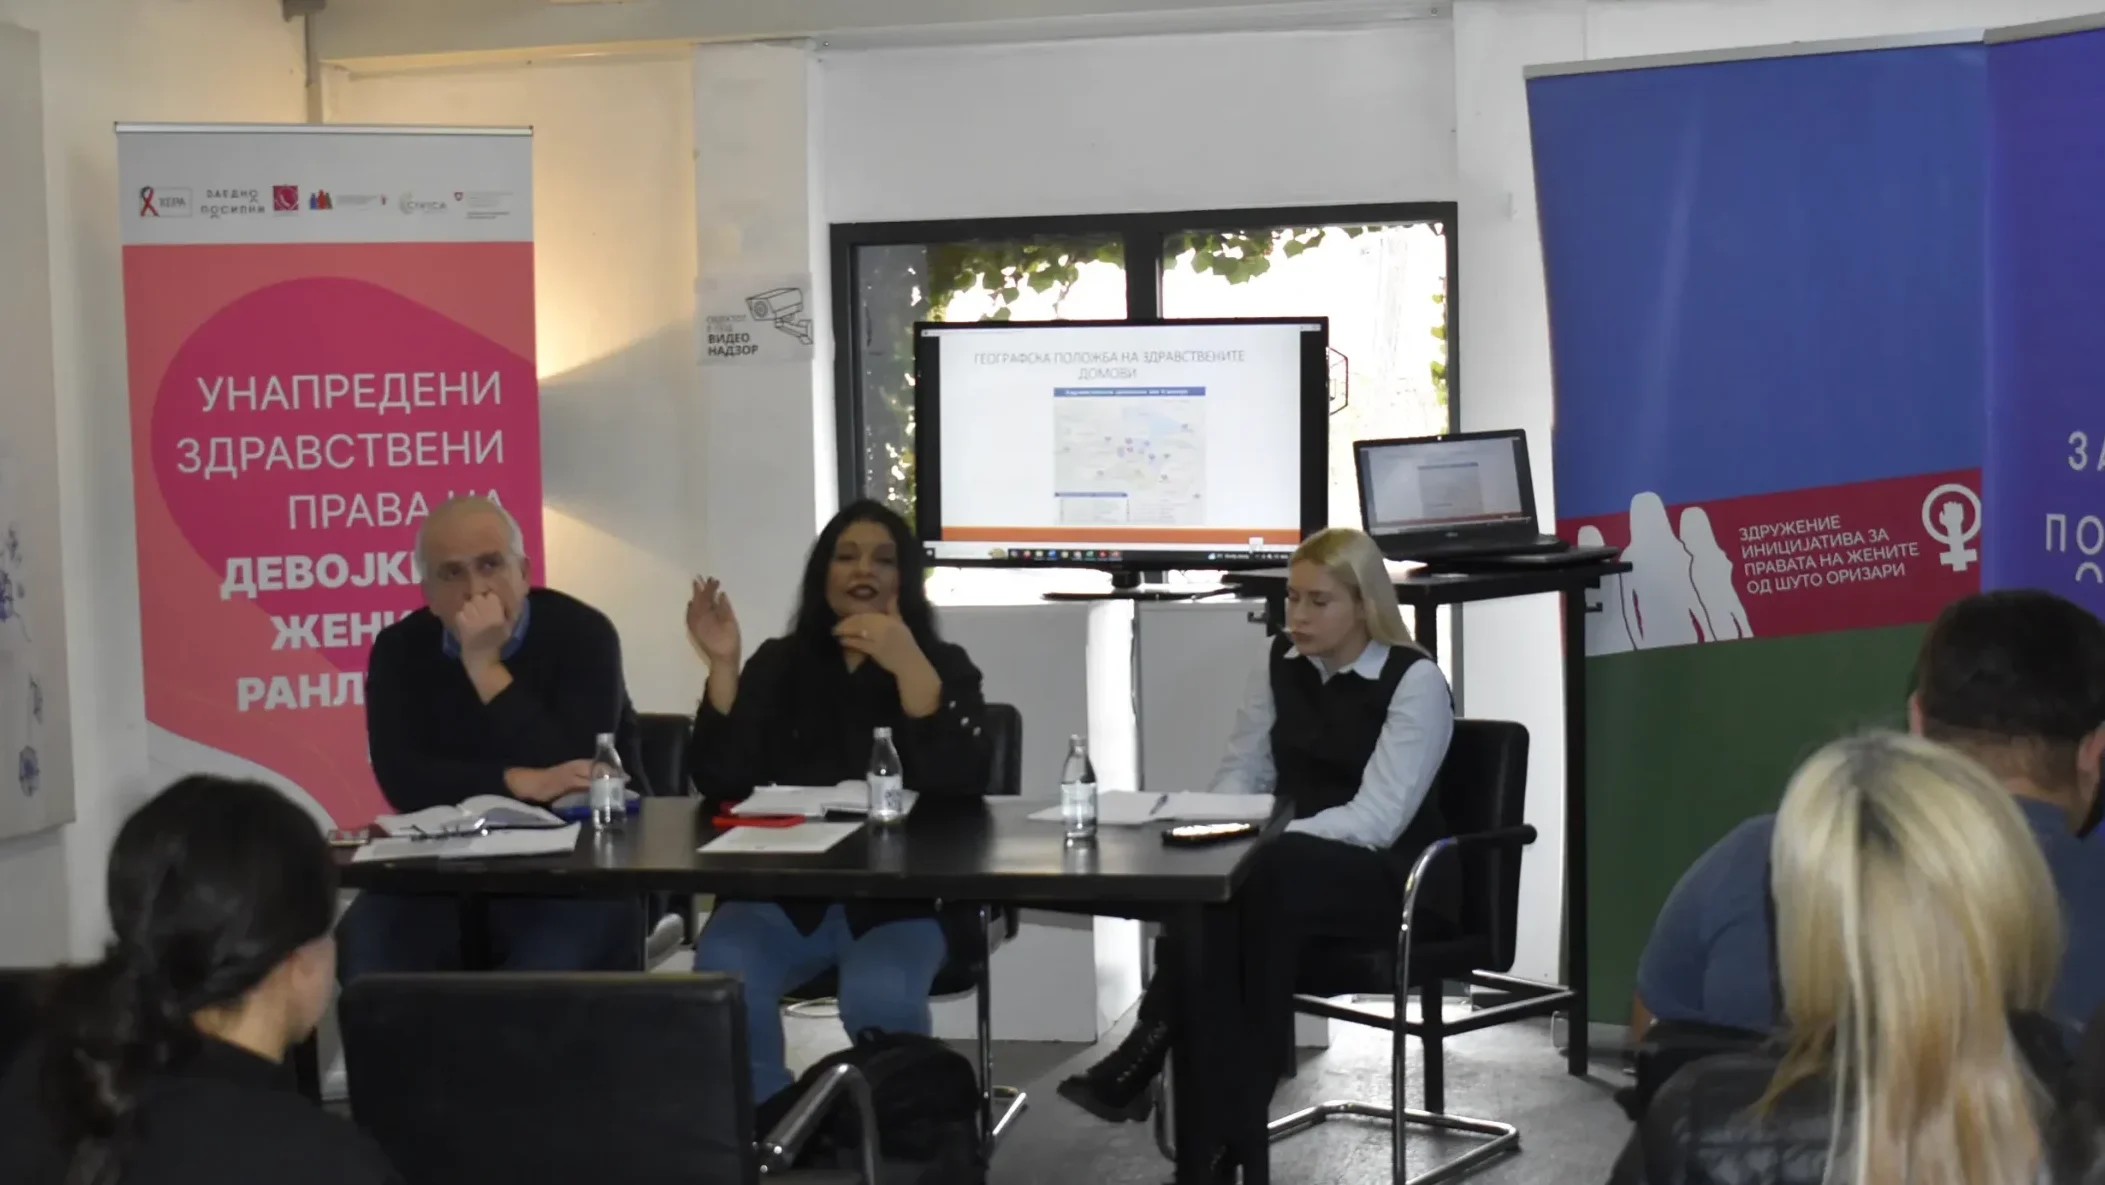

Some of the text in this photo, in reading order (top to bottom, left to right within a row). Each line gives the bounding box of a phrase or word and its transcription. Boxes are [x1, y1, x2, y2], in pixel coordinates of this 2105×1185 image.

[708, 333, 750, 344] ВИДЕО
[708, 345, 758, 357] НАДЗОР
[974, 350, 1245, 365] ГЕОГРАФСКА ПОЛОЖБА НА ЗДРАВСТВЕНИТЕ
[1078, 368, 1137, 380] ДОМОВИ
[197, 371, 502, 414] УНАПРЕДЕНИ
[176, 430, 504, 480] ЗДРАВСТВЕНИ
[288, 491, 429, 530] ПРАВА
[1739, 515, 1841, 541] ЗДРУЖЕНИЕ
[1742, 528, 1890, 559] ИНИЦИЈАТИВА ЗА
[1744, 542, 1920, 576] ПРАВАТА НА ЖЕНИТЕ
[1747, 562, 1906, 595] ОД ШУТО ОРИЗАРИ
